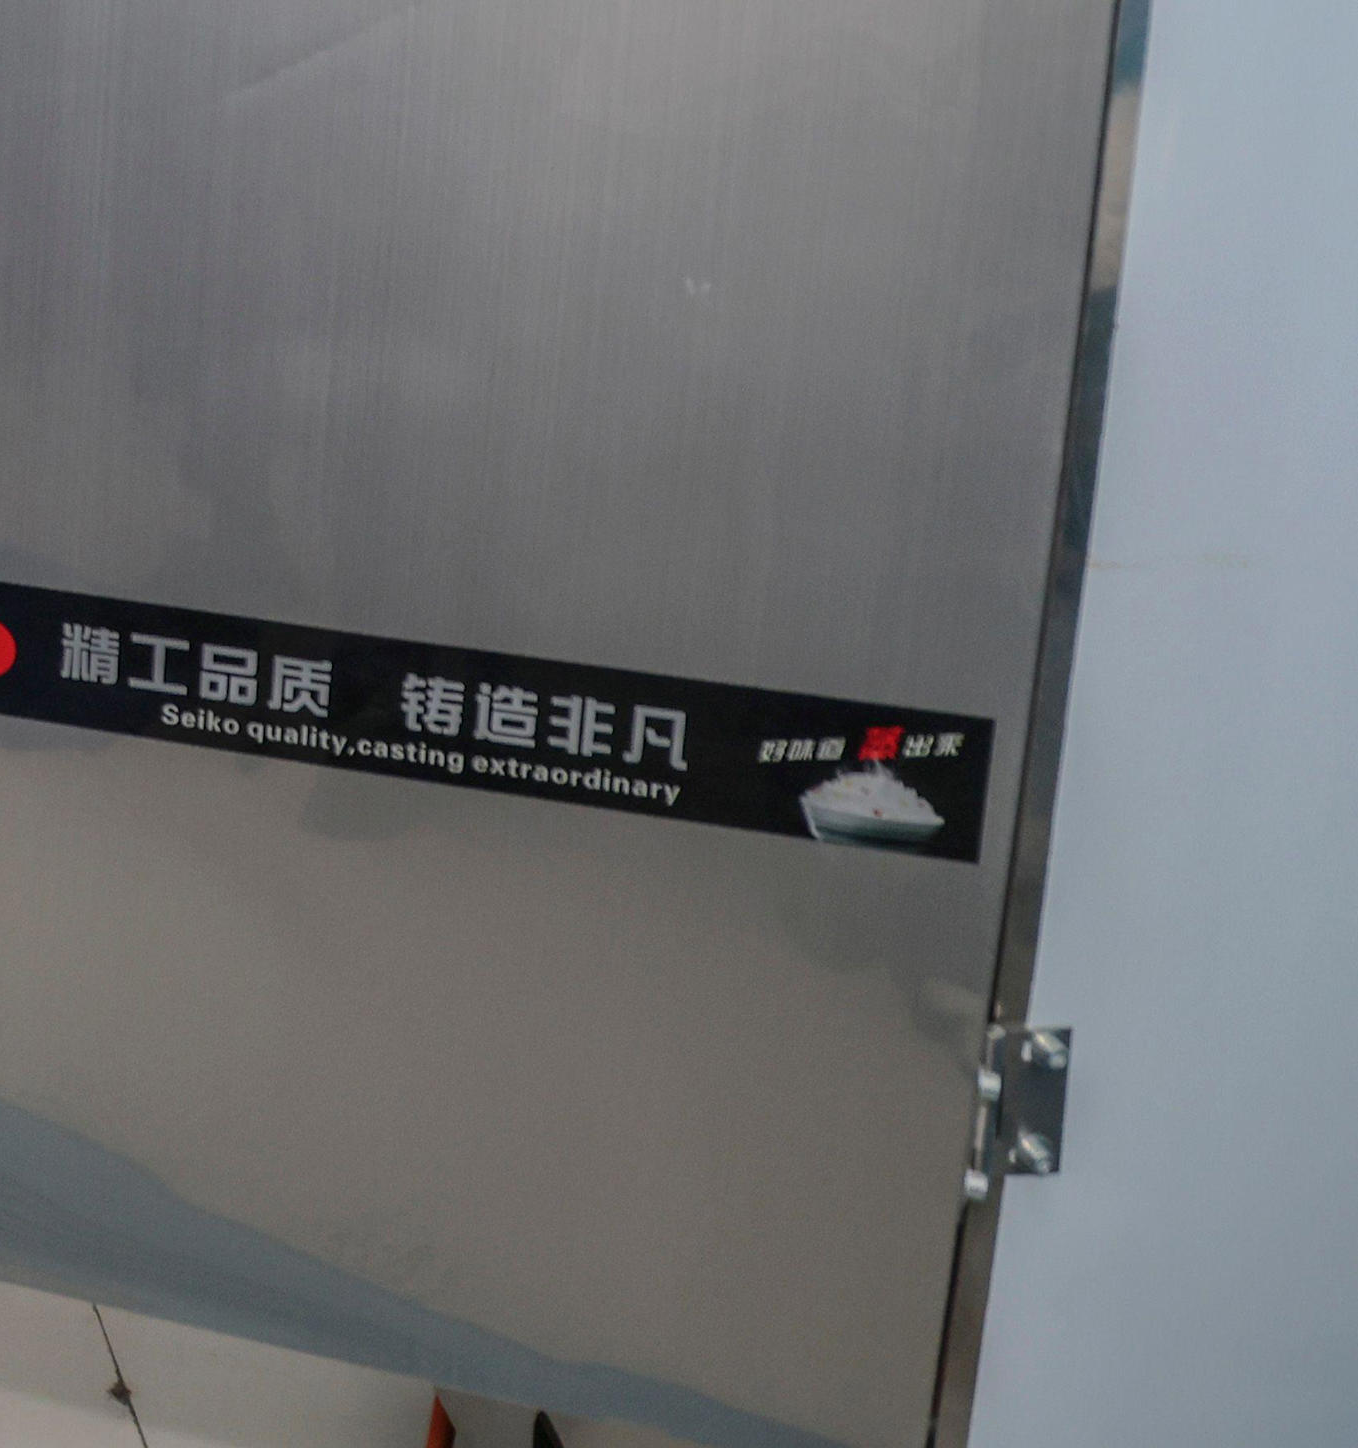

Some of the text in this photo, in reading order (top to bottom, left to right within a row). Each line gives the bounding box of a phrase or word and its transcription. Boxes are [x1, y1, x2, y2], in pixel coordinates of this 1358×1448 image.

[60, 622, 688, 772] 精工品质 铸造非凡
[161, 702, 240, 736] Seiko
[472, 753, 682, 806] extraordinary
